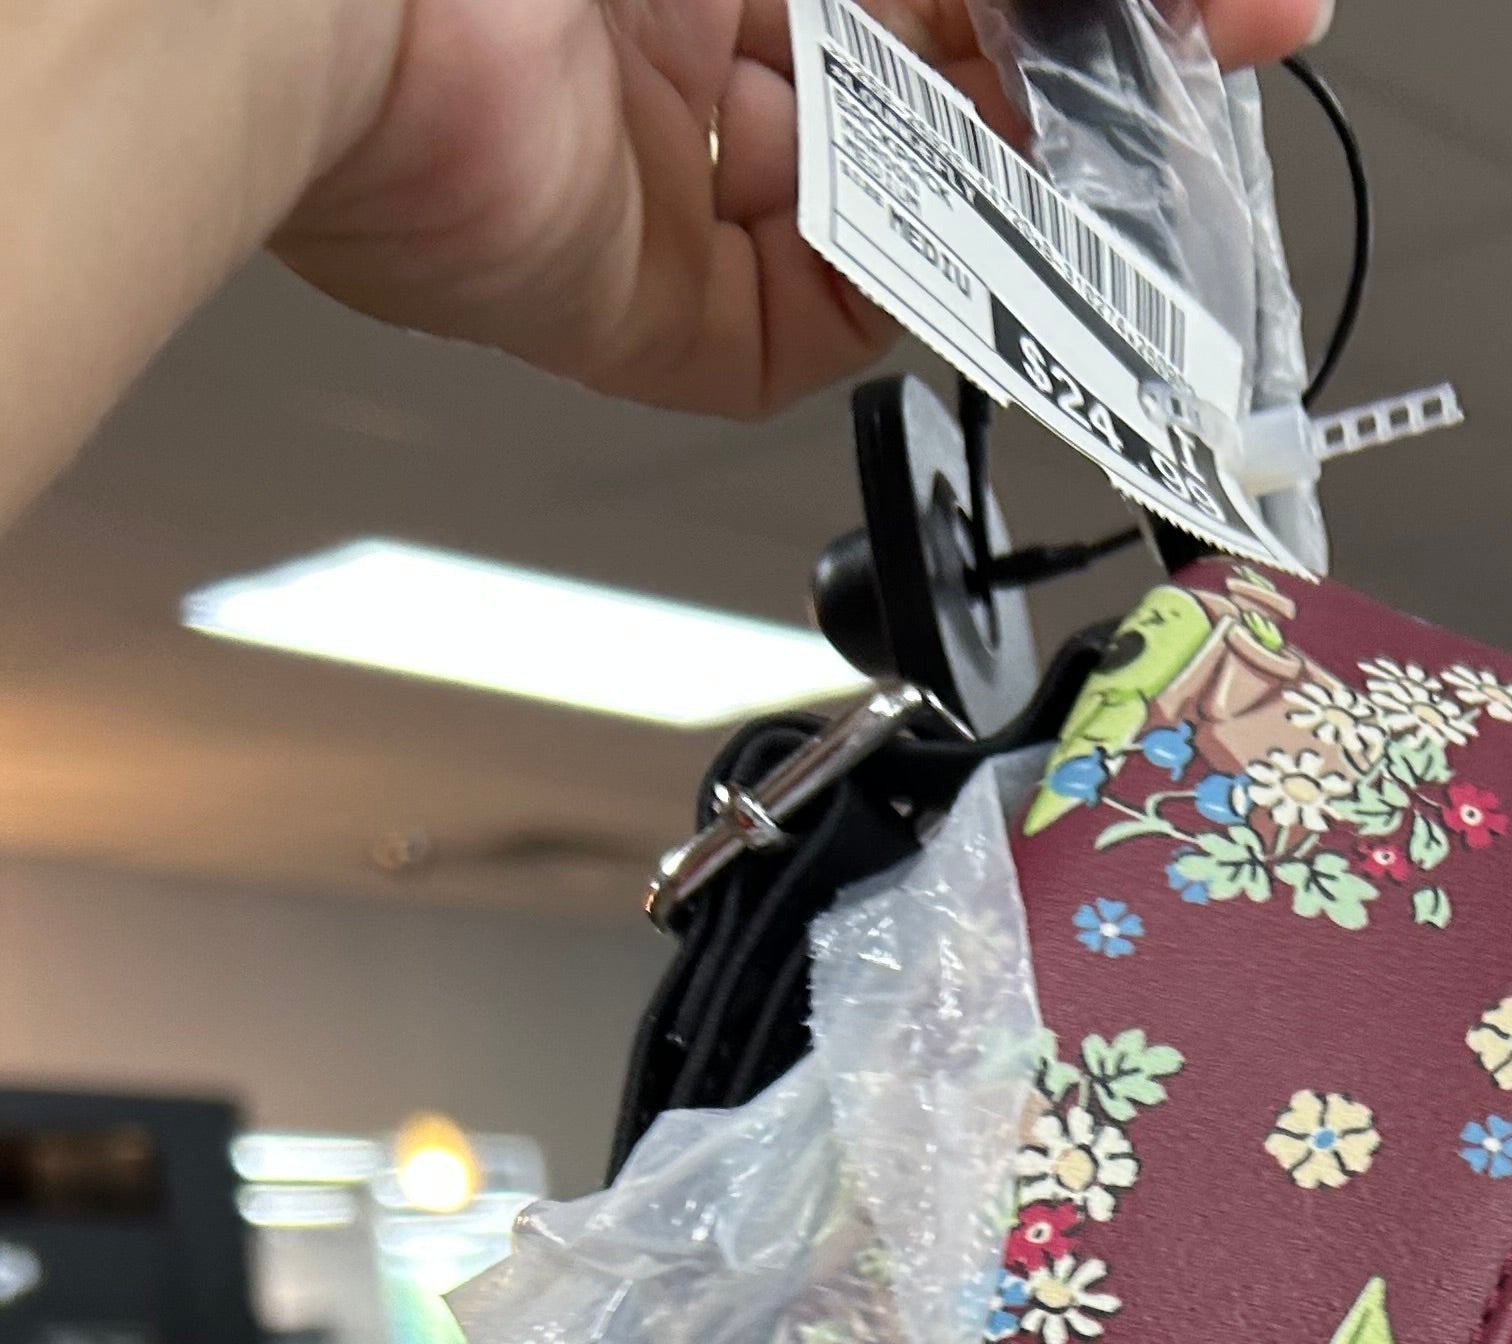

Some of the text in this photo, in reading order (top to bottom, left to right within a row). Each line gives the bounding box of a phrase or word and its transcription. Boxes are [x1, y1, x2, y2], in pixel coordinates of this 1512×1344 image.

[834, 87, 953, 212] BACKPACK
[887, 203, 971, 299] MEDIU
[1019, 335, 1227, 524] $24.99
